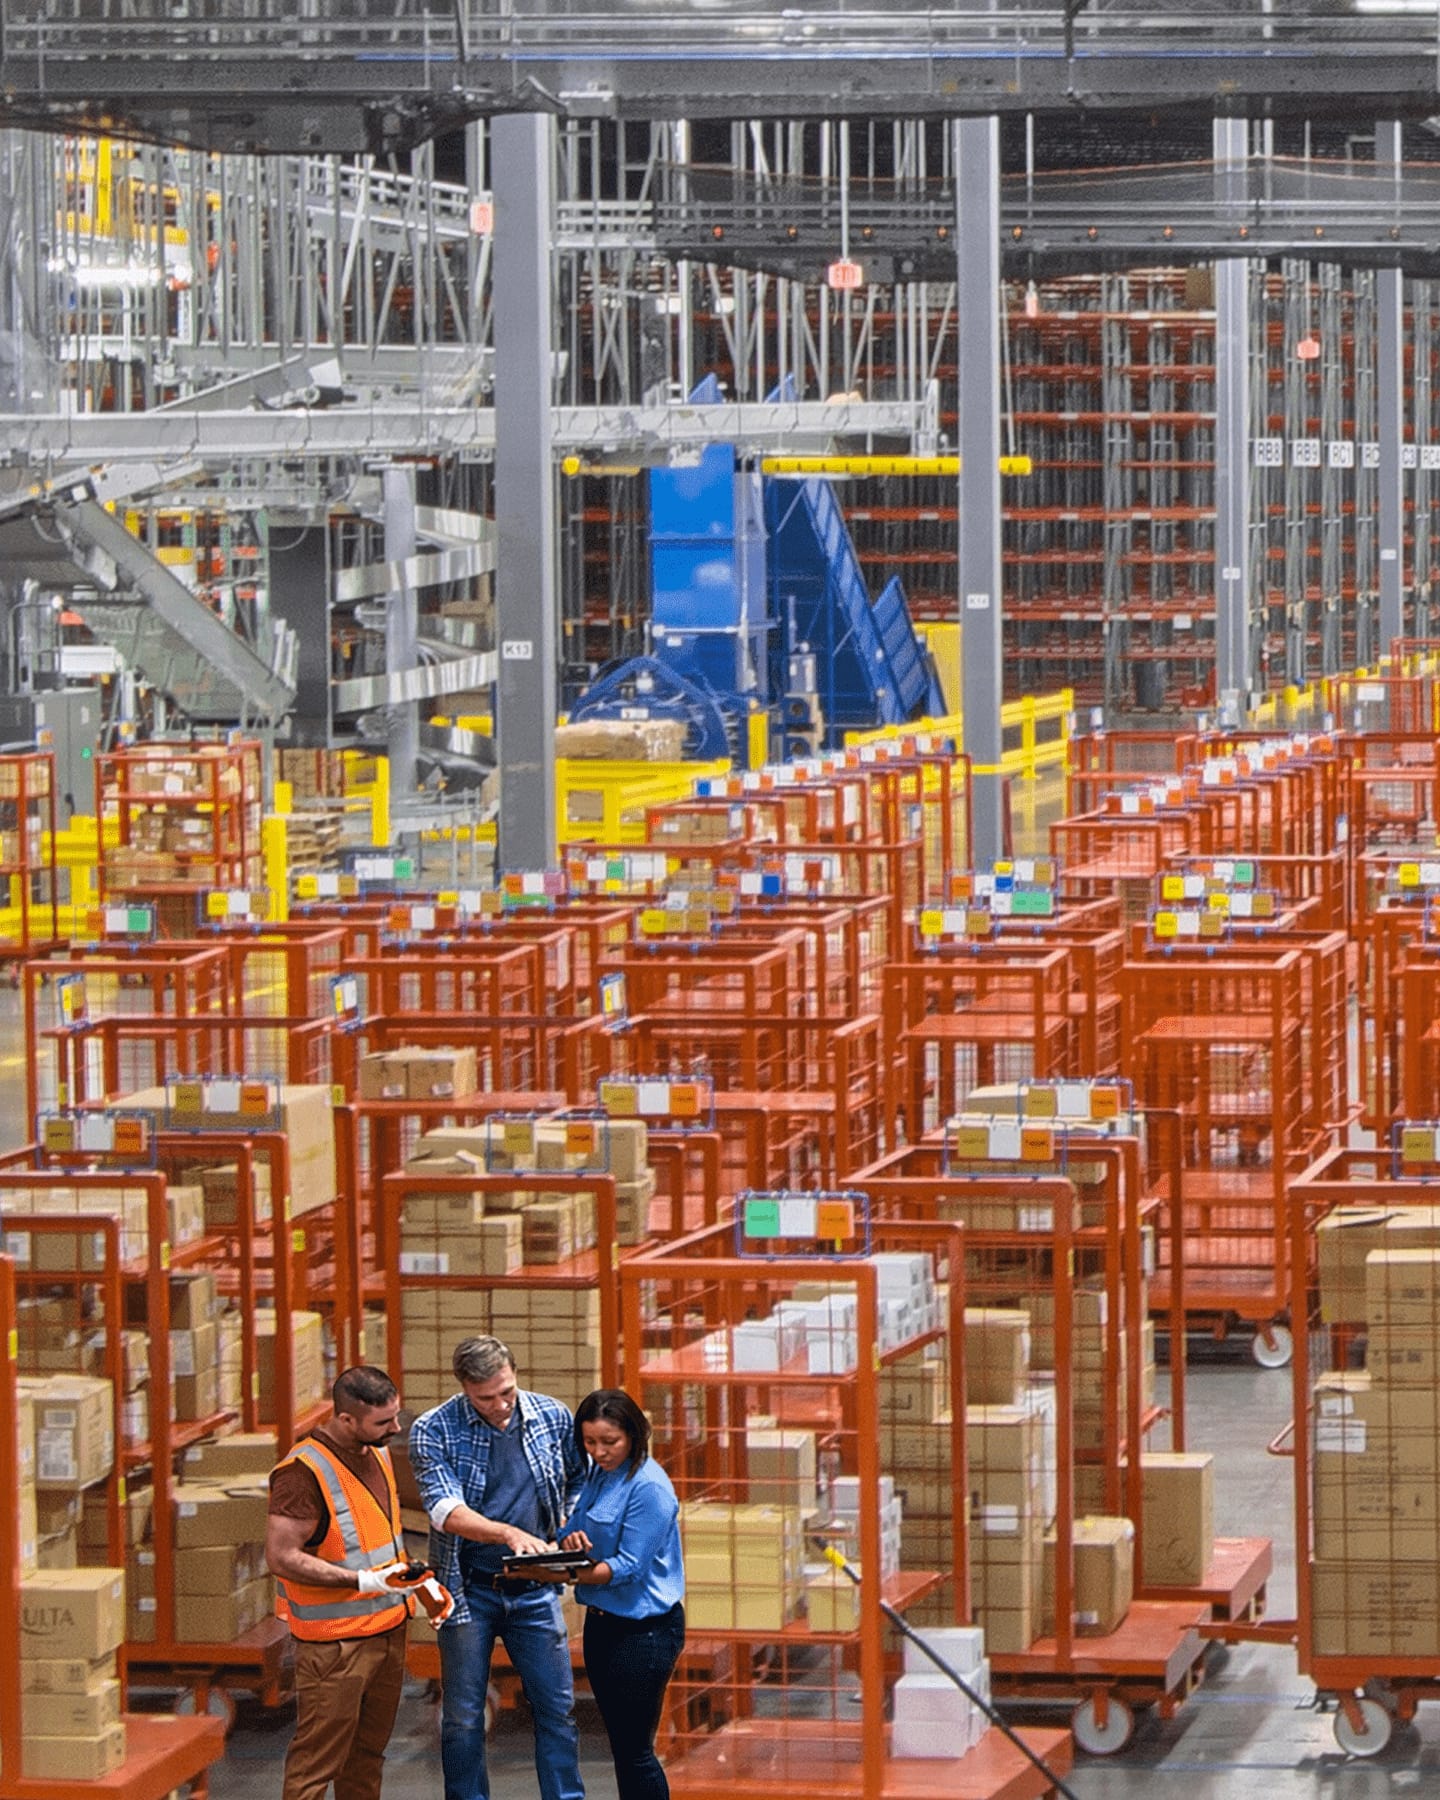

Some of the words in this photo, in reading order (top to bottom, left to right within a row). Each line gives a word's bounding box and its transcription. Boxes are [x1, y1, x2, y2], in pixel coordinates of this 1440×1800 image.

[1259, 442, 1279, 462] RB8
[1296, 443, 1318, 462] RB9
[1333, 445, 1351, 463] RC1
[1365, 446, 1380, 463] RC
[1402, 447, 1414, 464] C3
[1424, 448, 1440, 465] RC4
[505, 644, 530, 657] K13
[23, 1606, 75, 1627] ULTA
